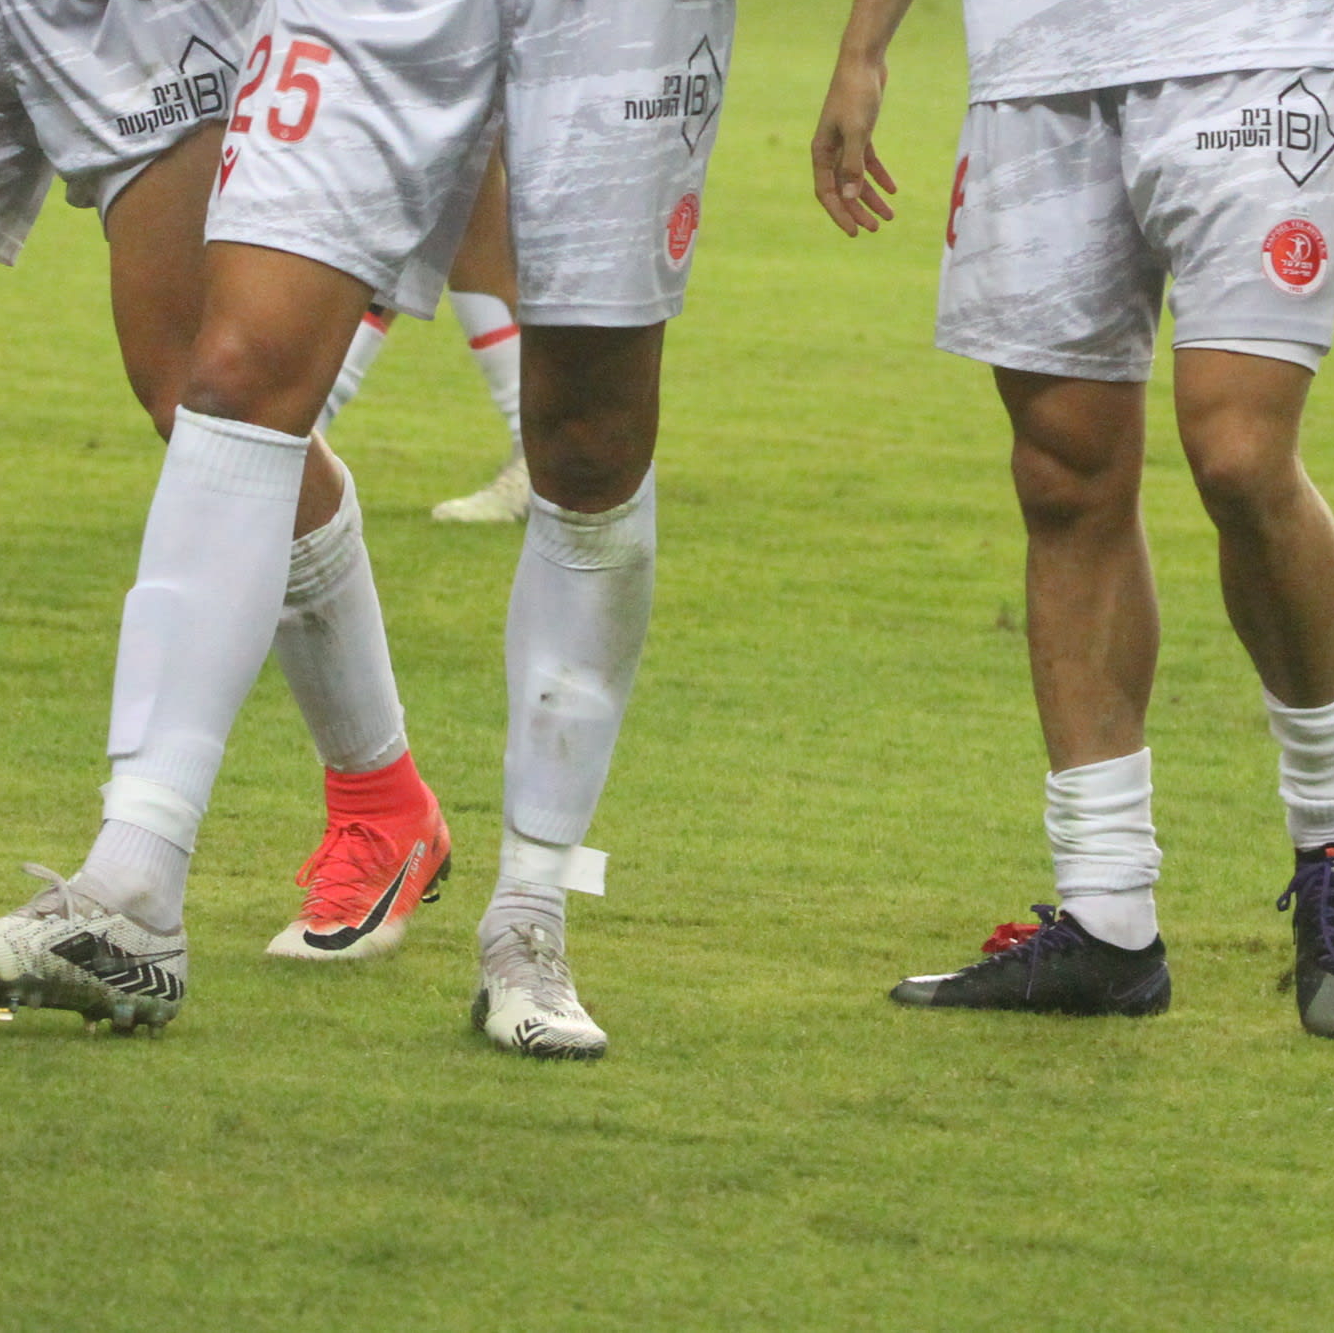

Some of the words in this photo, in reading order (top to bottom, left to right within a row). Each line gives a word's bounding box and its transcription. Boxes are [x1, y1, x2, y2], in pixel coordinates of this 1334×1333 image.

[152, 82, 183, 106] בית
[184, 69, 229, 118] IBI
[229, 34, 332, 143] 25
[116, 103, 189, 137] השקעות
[1241, 108, 1272, 126] בית
[1278, 109, 1319, 154] IBI
[1195, 128, 1271, 151] השקעות
